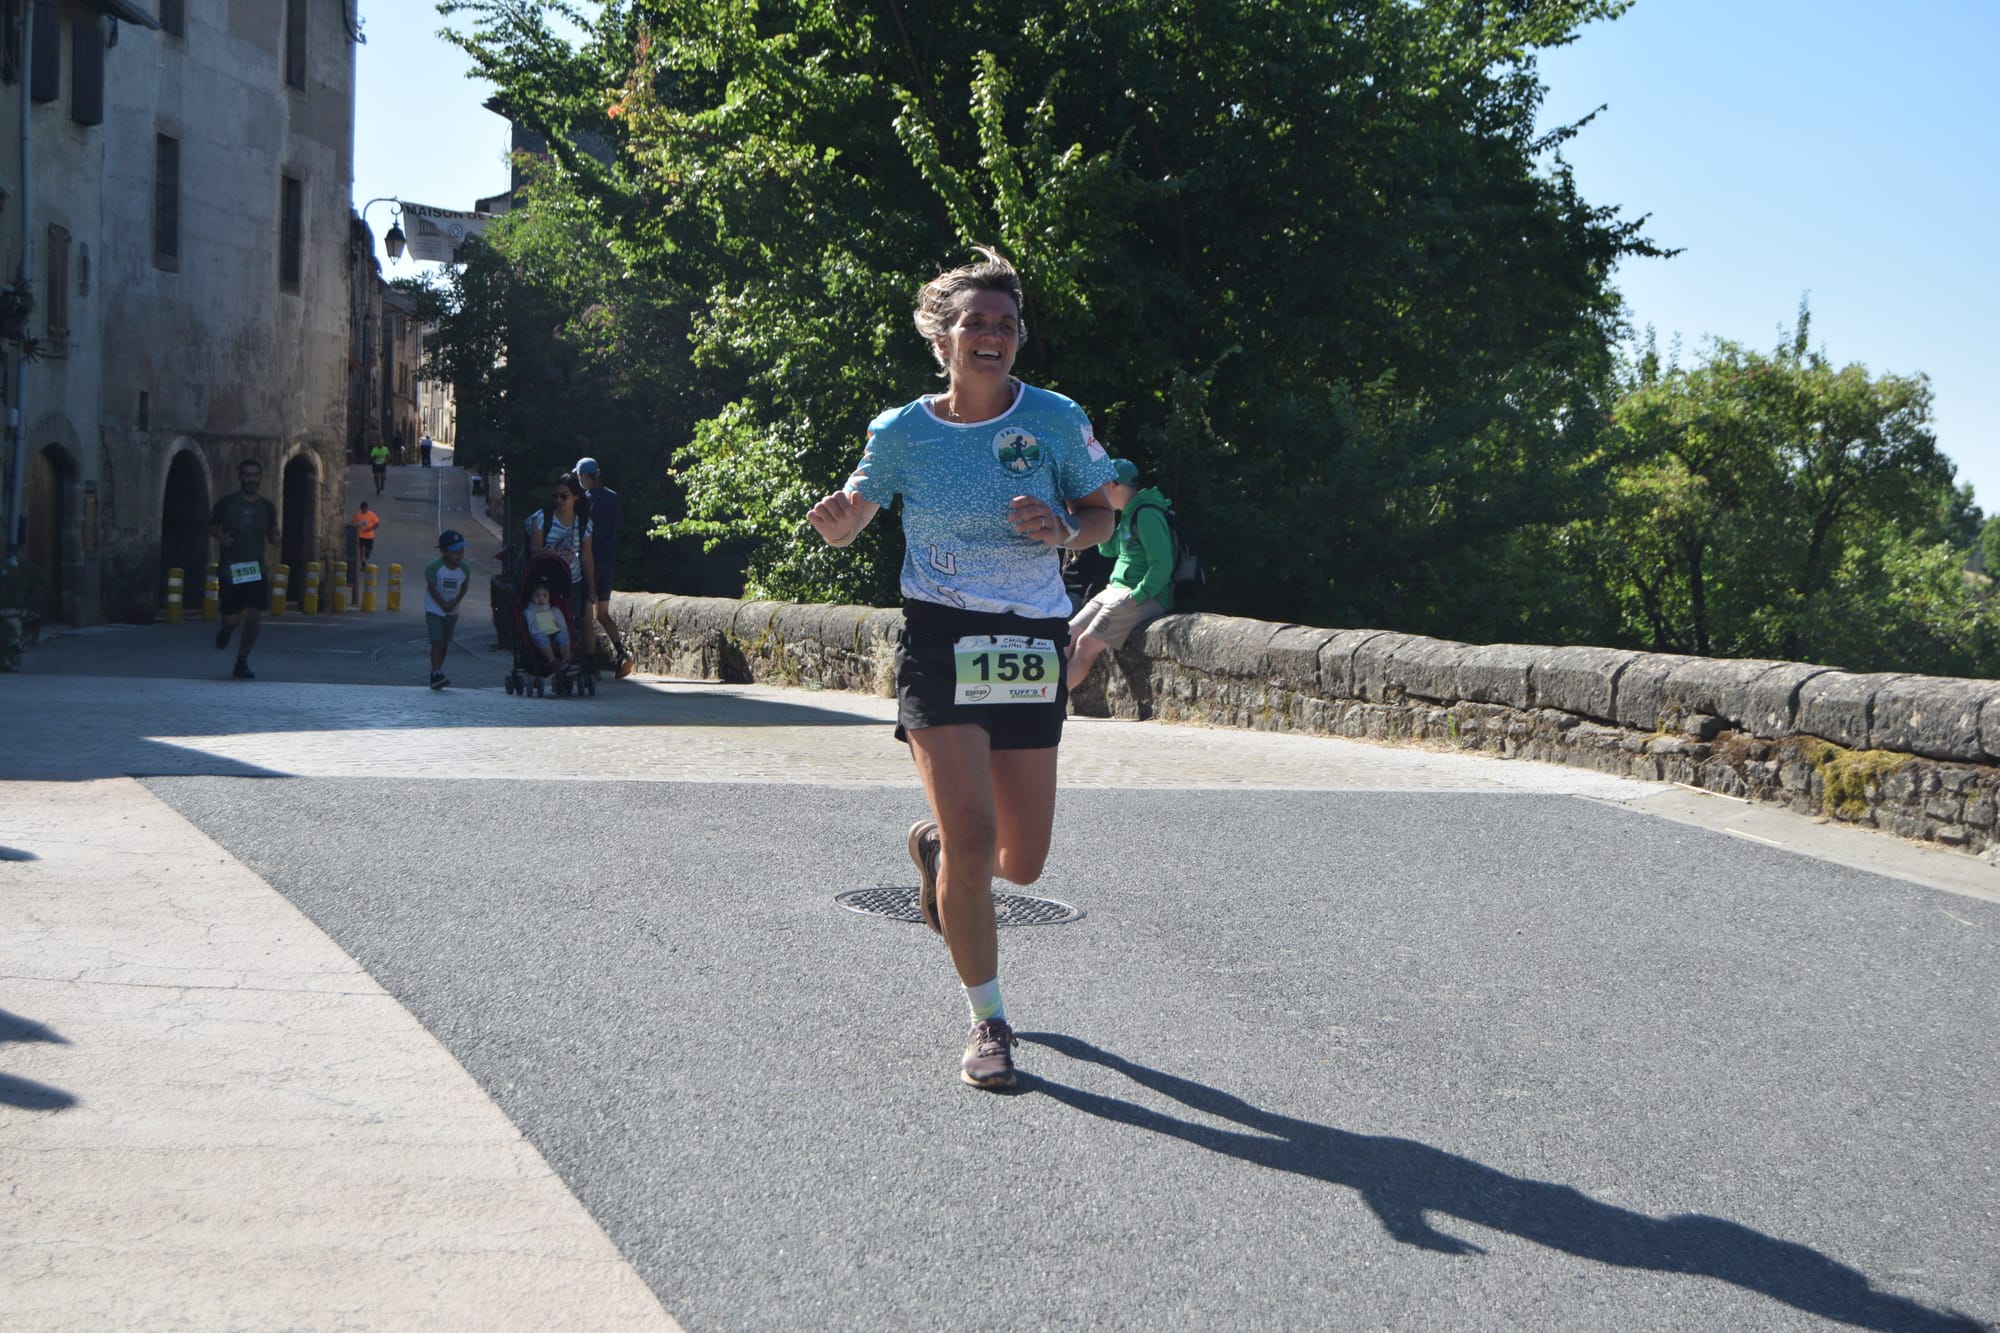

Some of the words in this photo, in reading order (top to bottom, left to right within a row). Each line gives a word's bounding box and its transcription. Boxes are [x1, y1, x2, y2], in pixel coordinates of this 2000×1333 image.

[406, 206, 463, 219] MAISON
[235, 566, 256, 577] 159
[973, 653, 1045, 681] 158
